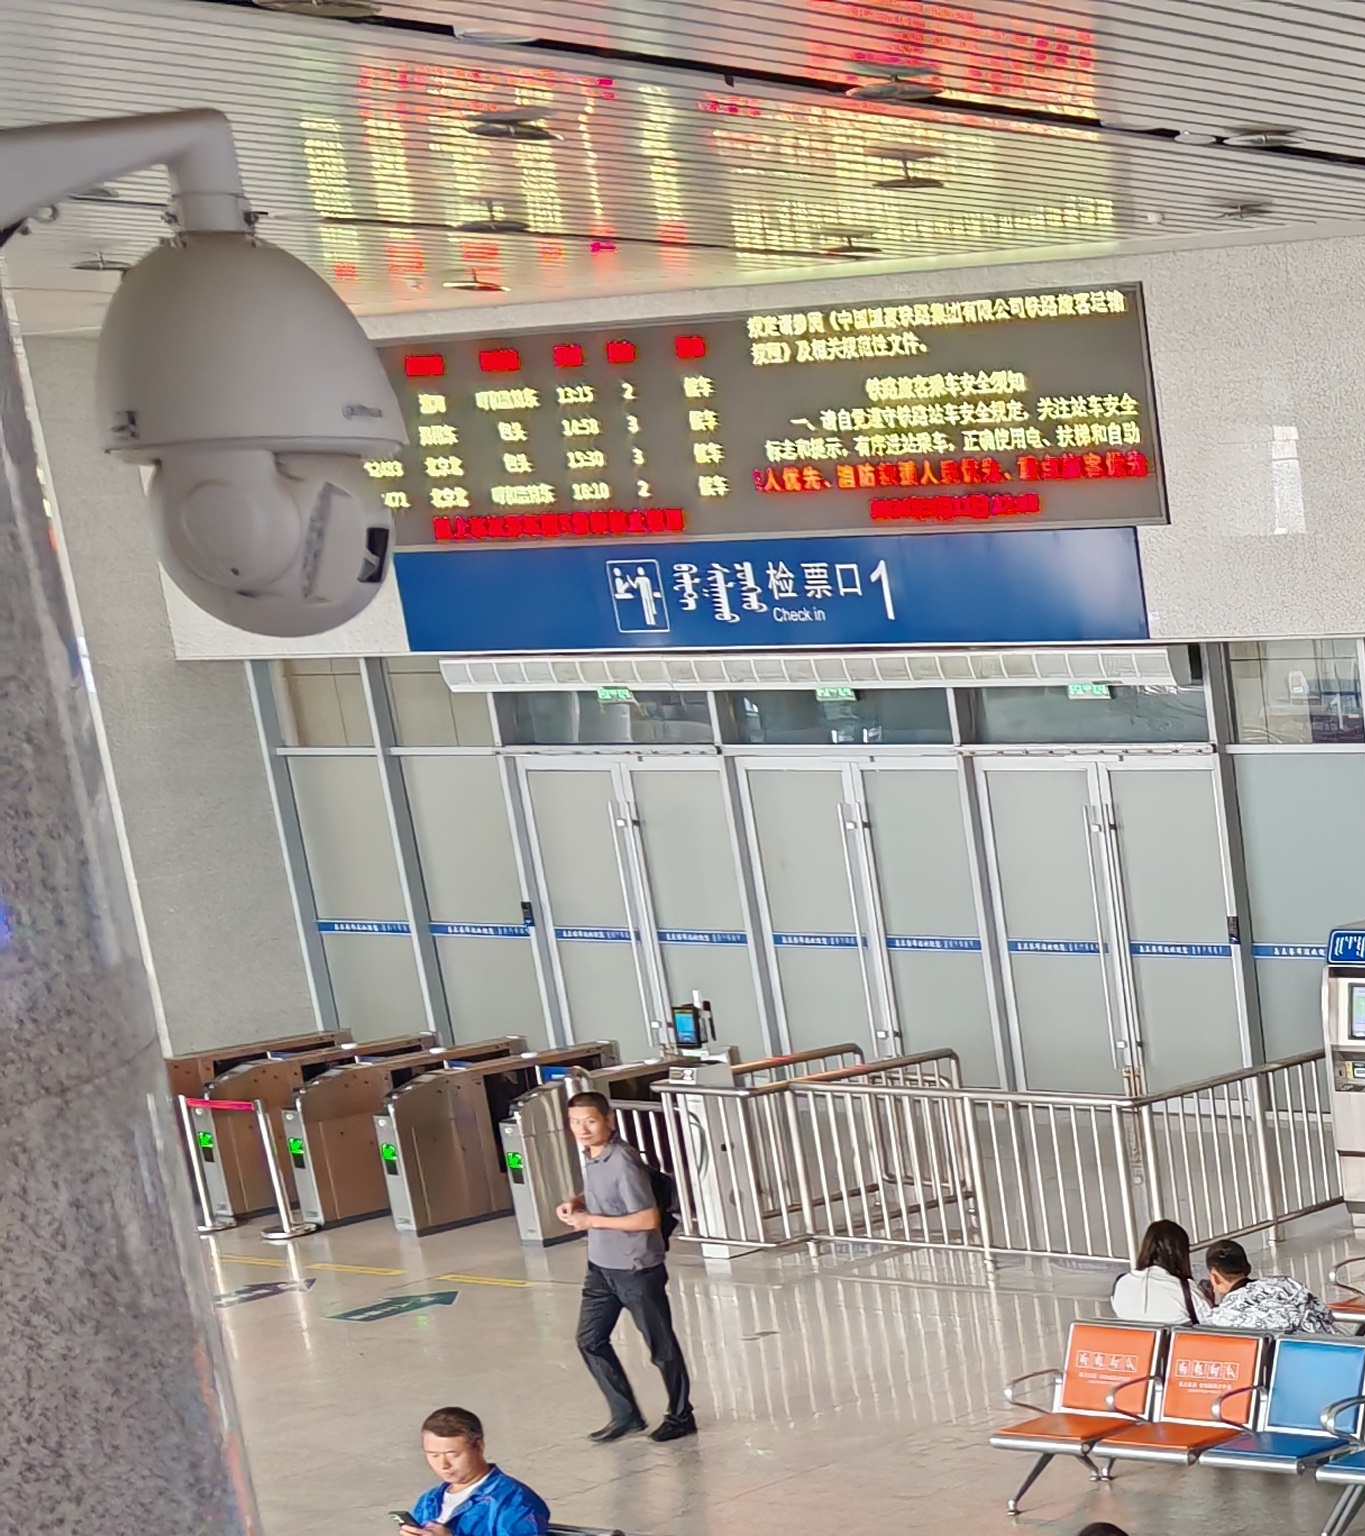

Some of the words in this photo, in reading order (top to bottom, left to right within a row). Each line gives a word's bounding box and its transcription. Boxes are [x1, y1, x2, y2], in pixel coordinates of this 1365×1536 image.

[621, 382, 636, 400] 2
[637, 480, 652, 498] 2
[766, 560, 863, 600] 检票口
[773, 606, 811, 622] Check
[813, 606, 826, 621] in
